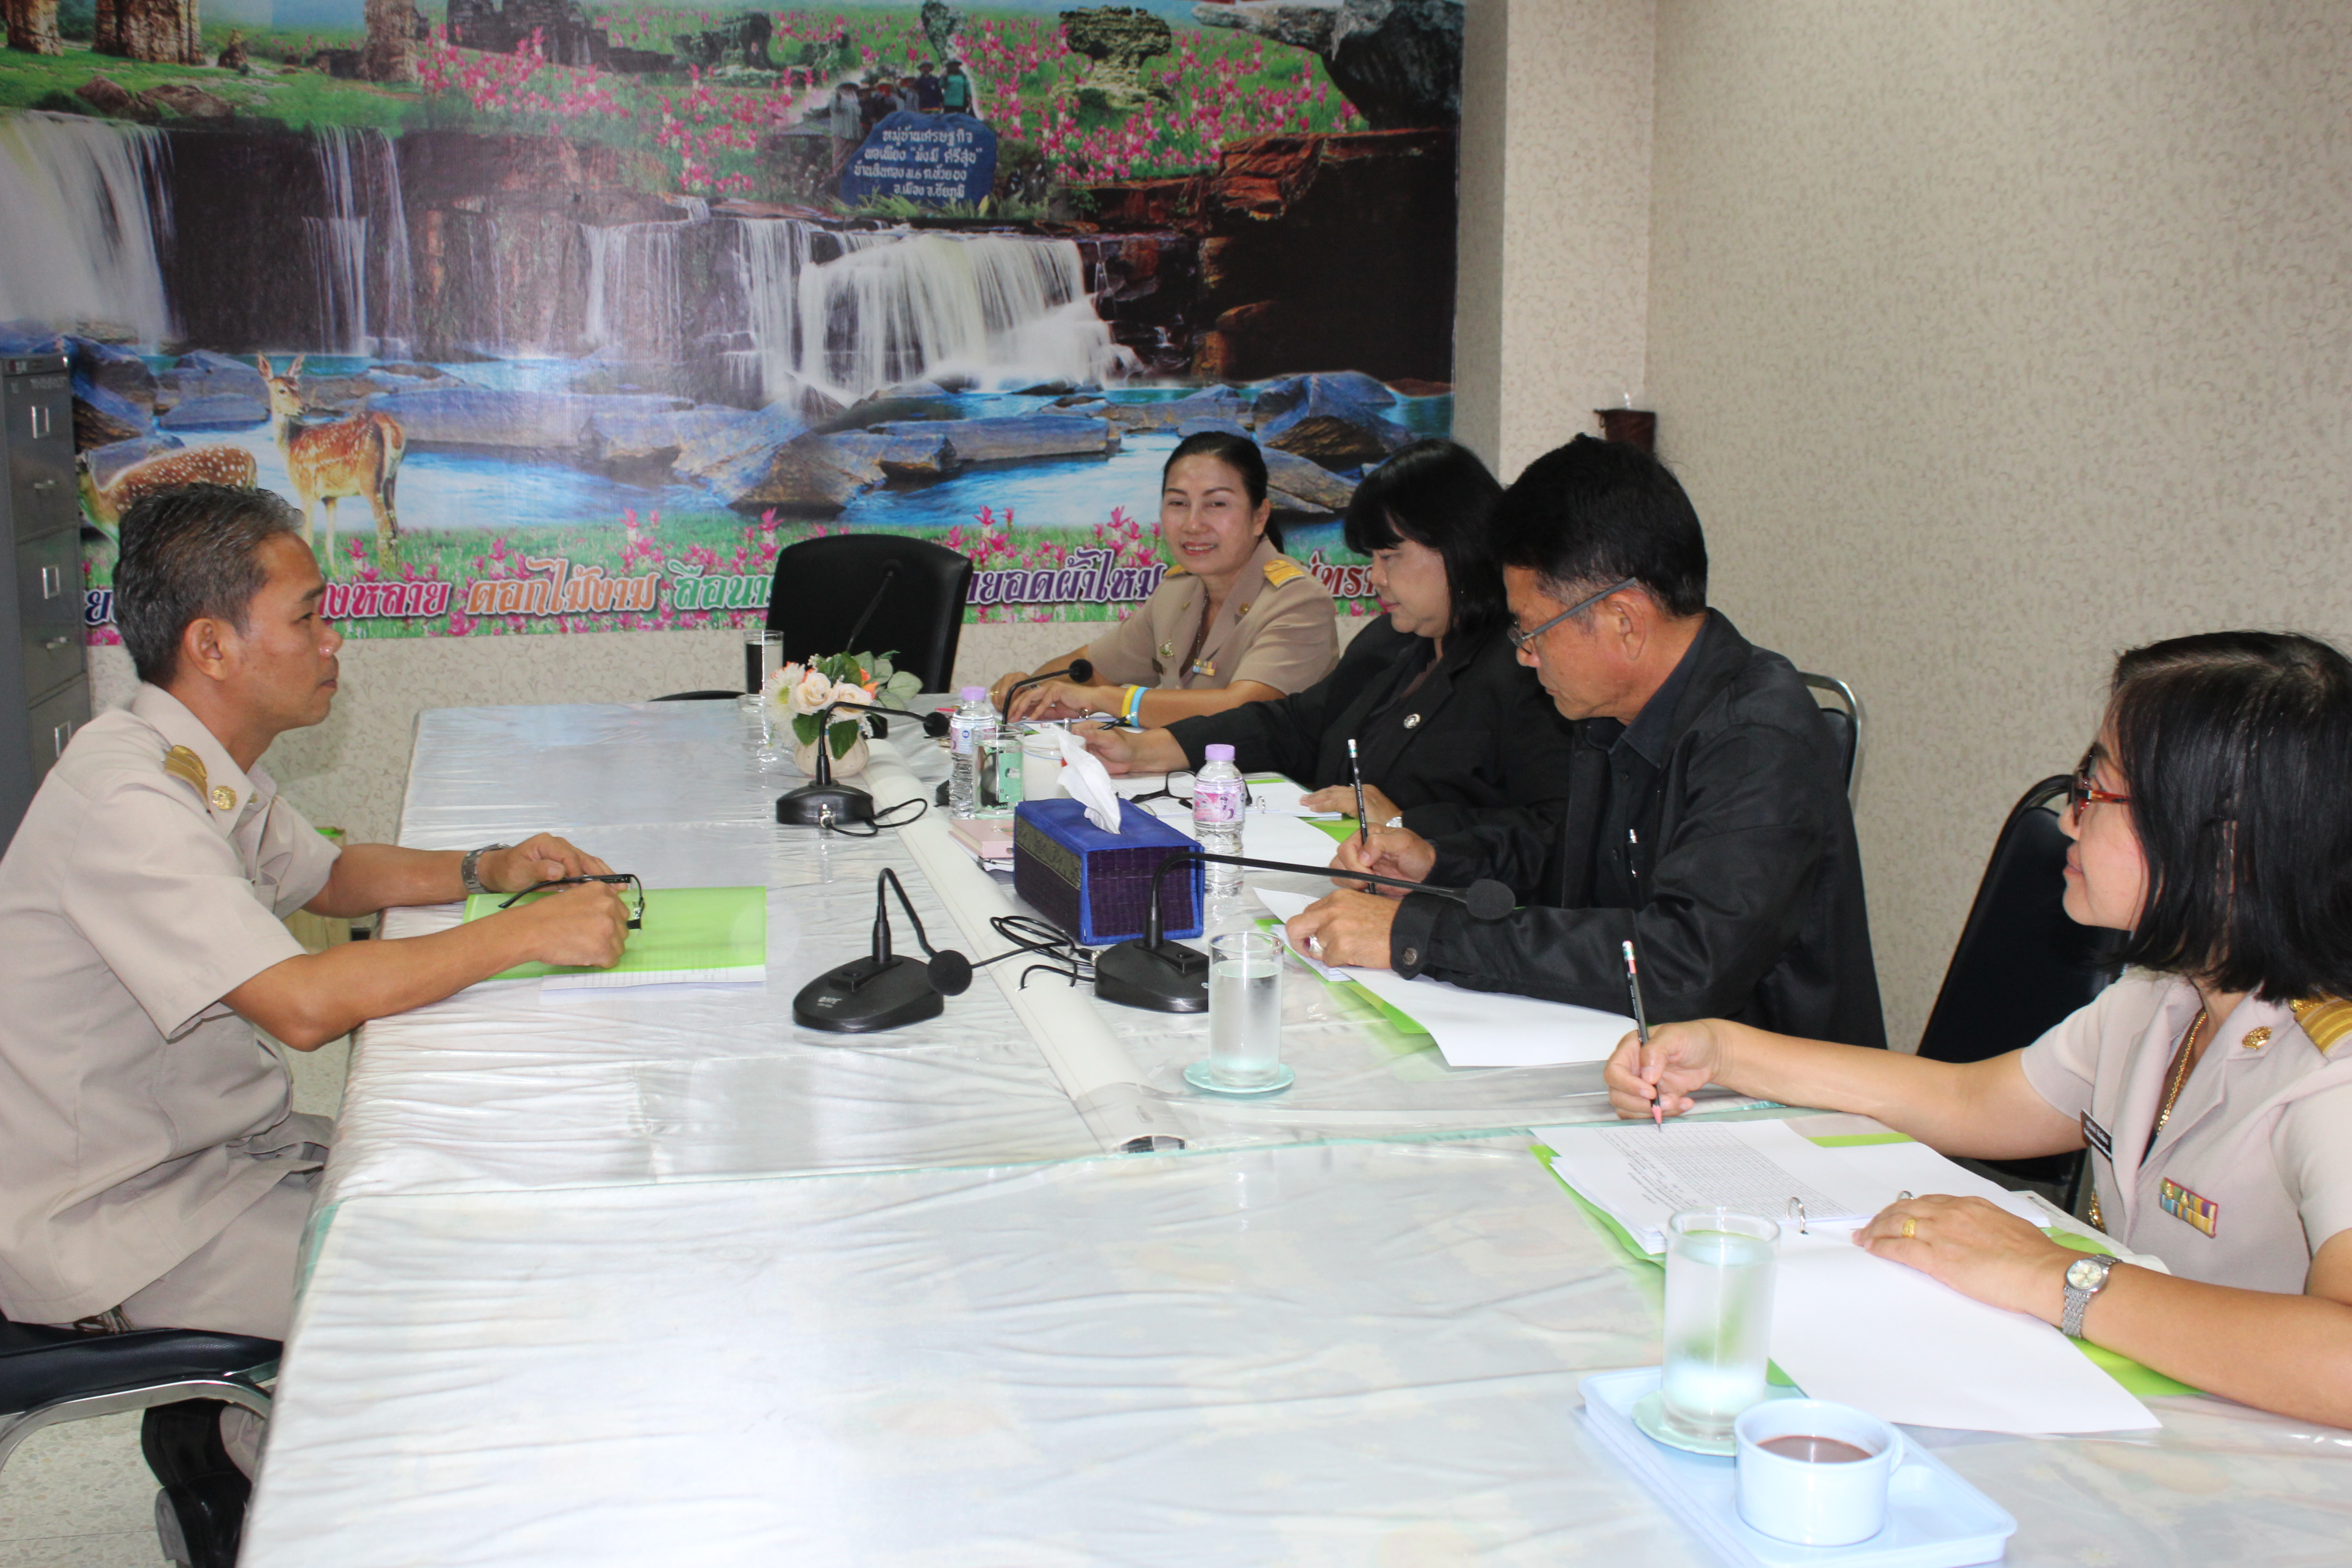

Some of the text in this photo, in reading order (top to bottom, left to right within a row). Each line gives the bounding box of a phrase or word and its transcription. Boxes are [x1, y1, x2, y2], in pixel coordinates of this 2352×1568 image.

[465, 556, 662, 617] ดอกไม้งาม
[667, 559, 774, 610] ลือนา
